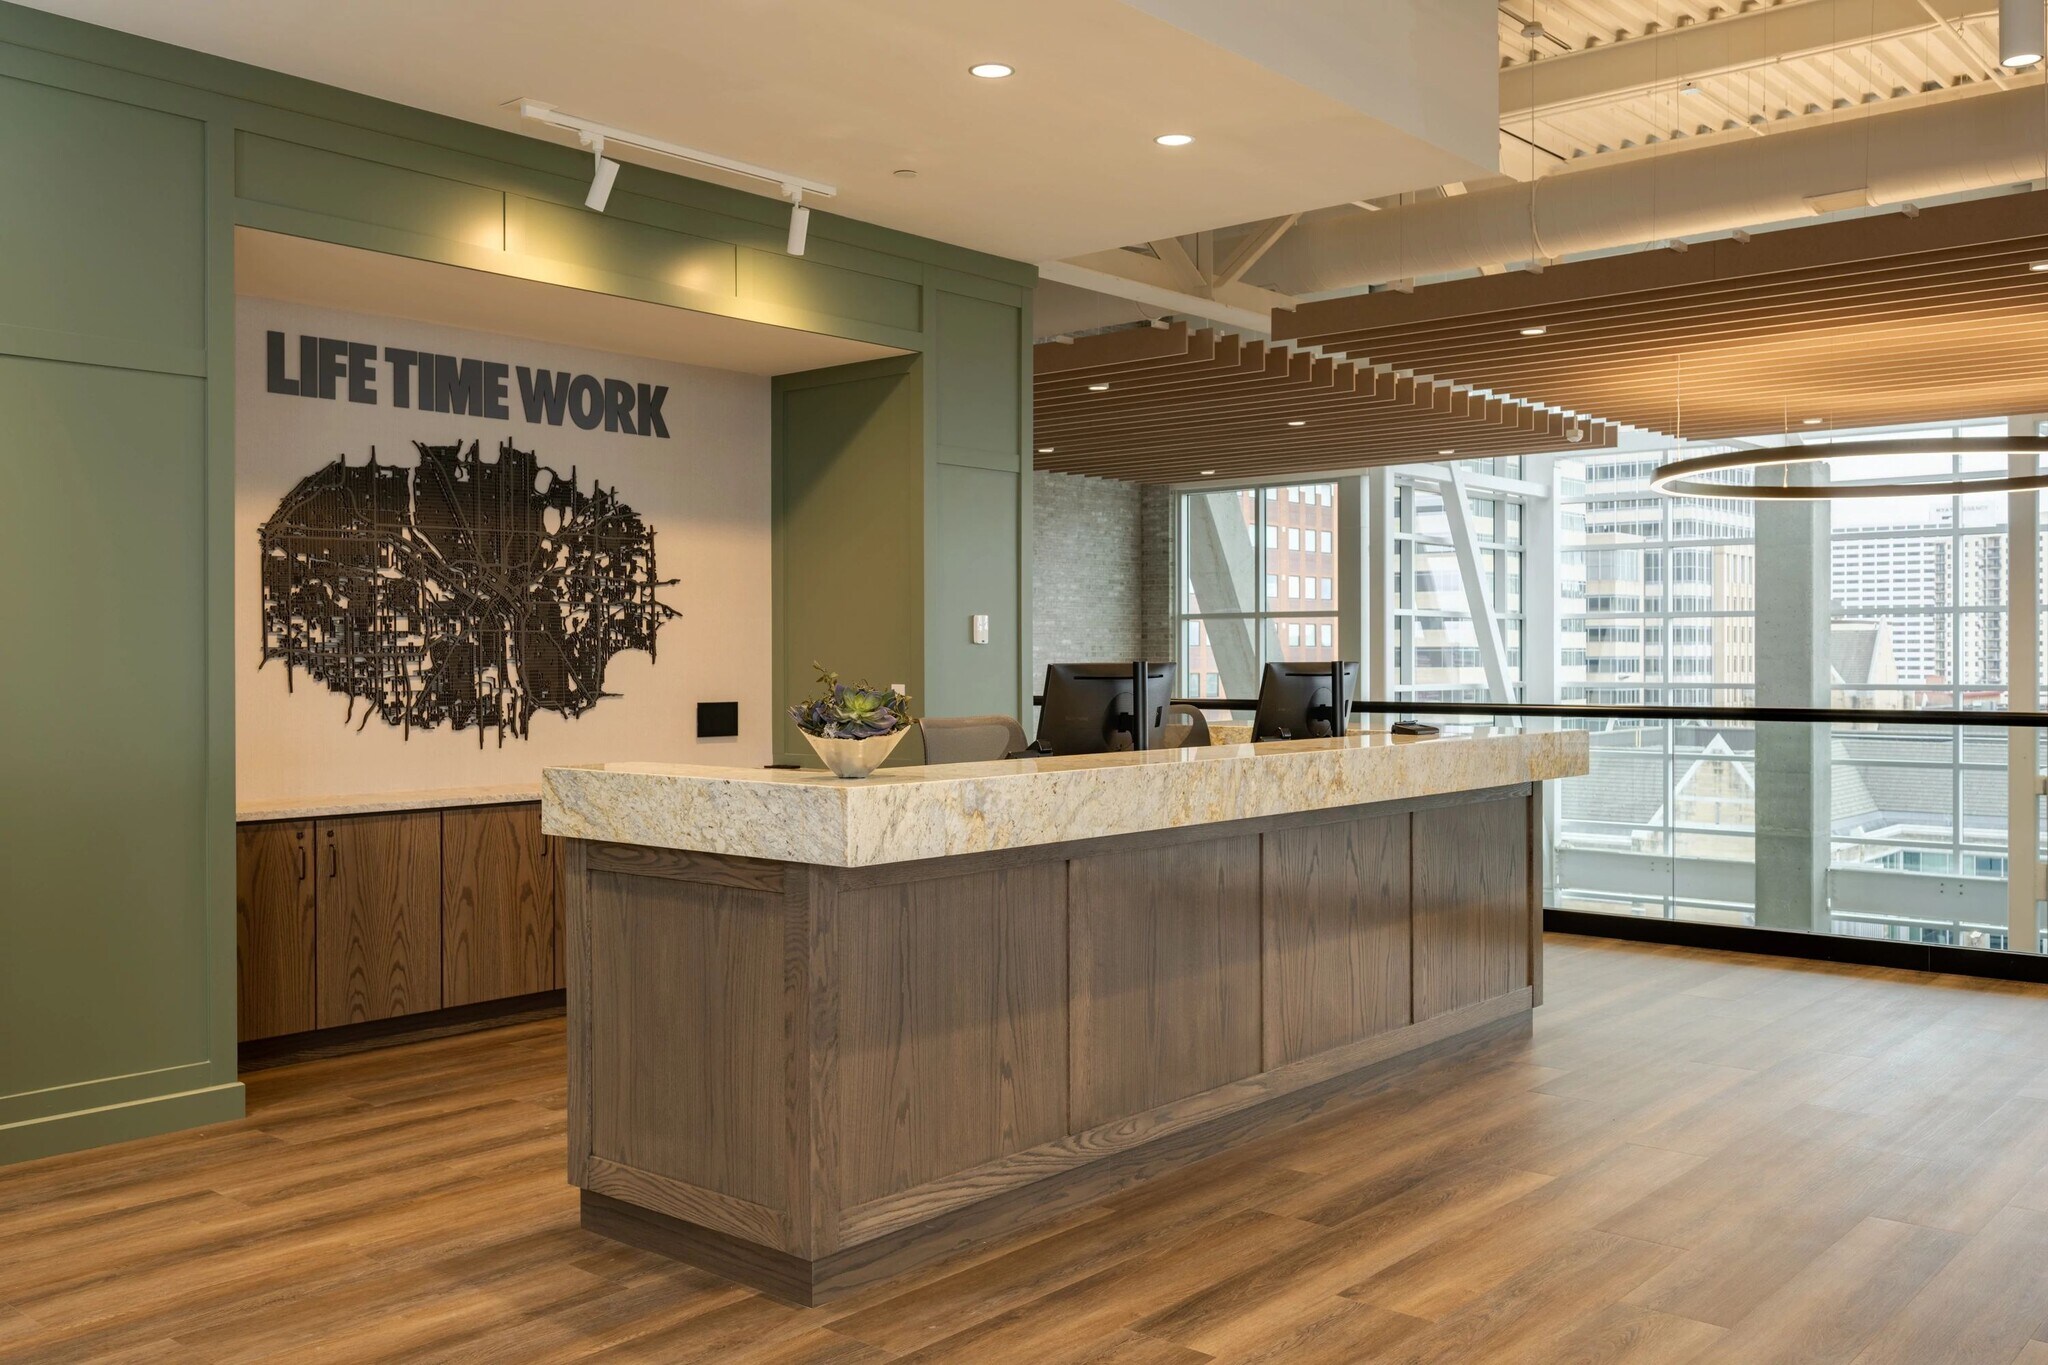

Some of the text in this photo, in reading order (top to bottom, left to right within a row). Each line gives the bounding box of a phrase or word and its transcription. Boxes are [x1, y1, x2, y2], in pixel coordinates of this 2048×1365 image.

[266, 330, 671, 439] LIFE TIME WORK
